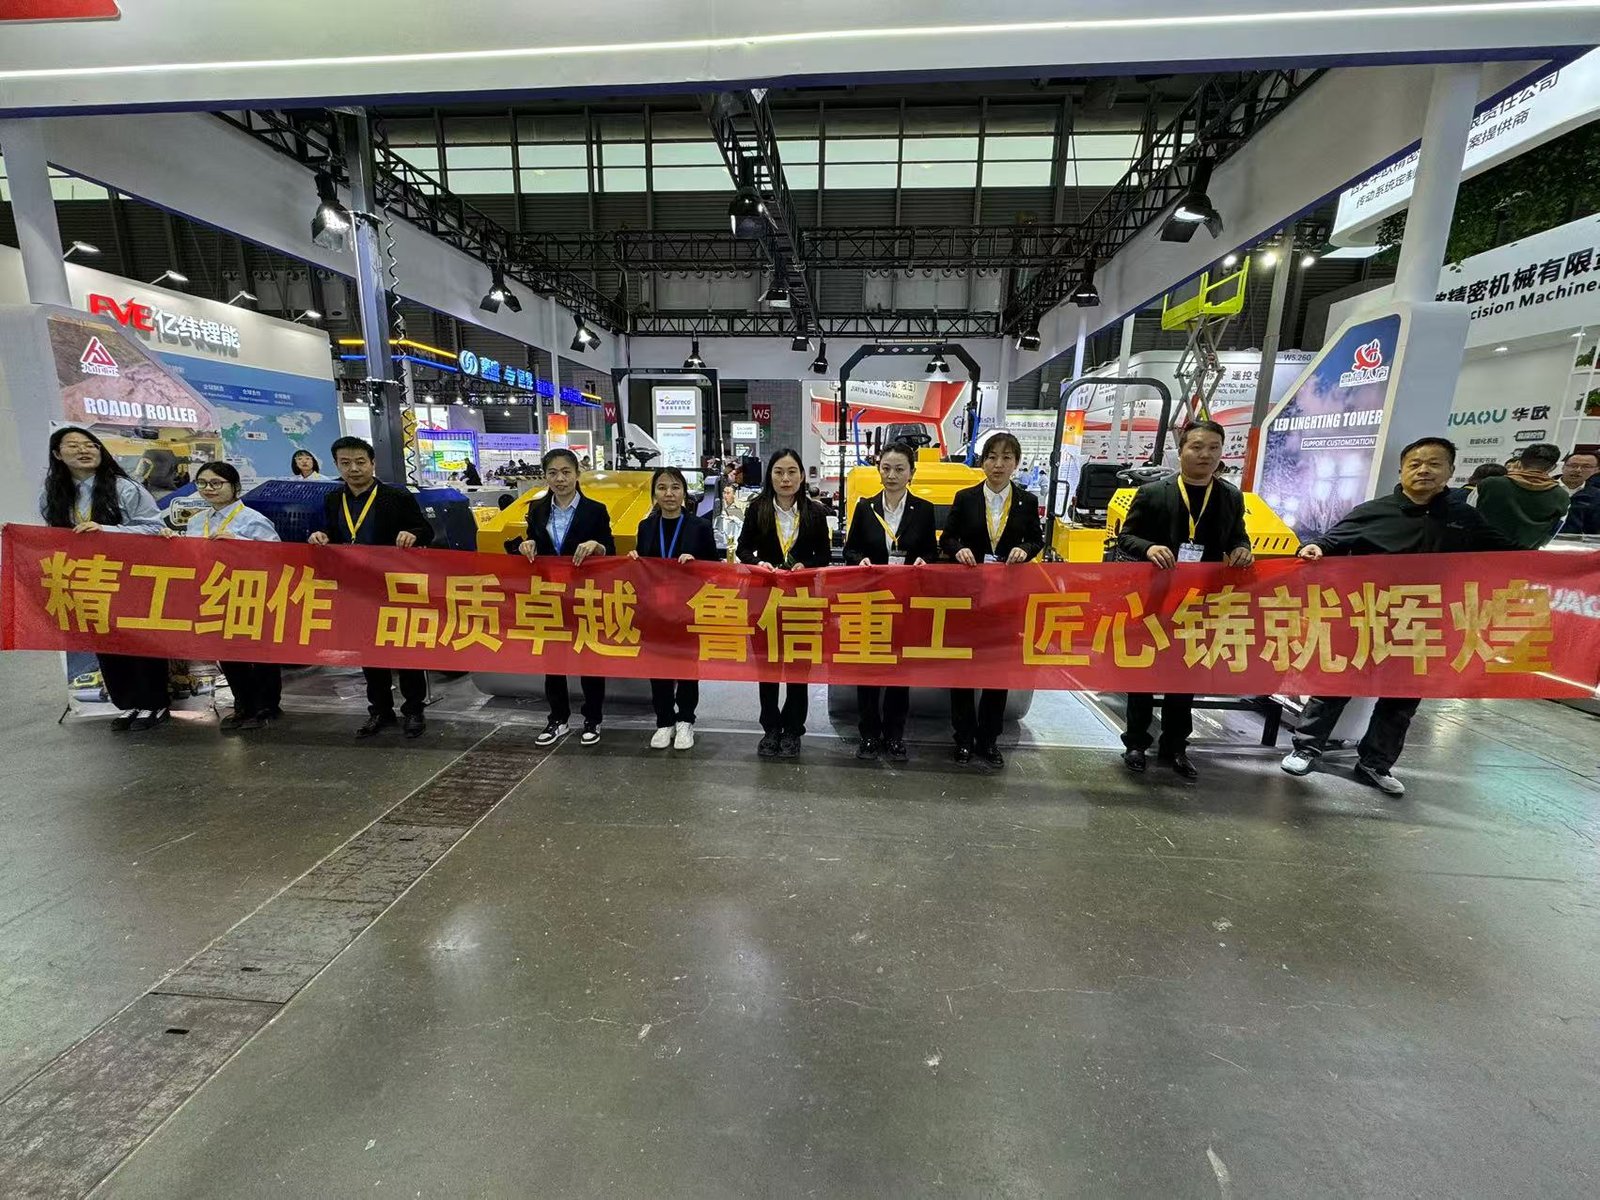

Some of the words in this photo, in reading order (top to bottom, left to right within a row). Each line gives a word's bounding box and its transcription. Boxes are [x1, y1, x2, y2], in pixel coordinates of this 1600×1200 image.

[1435, 246, 1600, 304] 精密机械有限
[1519, 279, 1600, 308] Machine
[153, 306, 241, 348] 亿纬锂能
[83, 397, 142, 418] ROADO
[145, 404, 198, 423] ROLLER
[753, 409, 770, 420] W5
[1273, 418, 1290, 431] LED
[1290, 414, 1341, 431] LINGHTING
[1343, 409, 1384, 427] TOWER
[1511, 405, 1551, 421] 华欧
[1327, 438, 1375, 446] CUSTOMIZATION
[39, 551, 338, 646] 精工细作
[375, 571, 642, 657] 品质卓越
[686, 583, 973, 664] 鲁信重工
[1022, 579, 1555, 676] 匠心铸就辉煌
